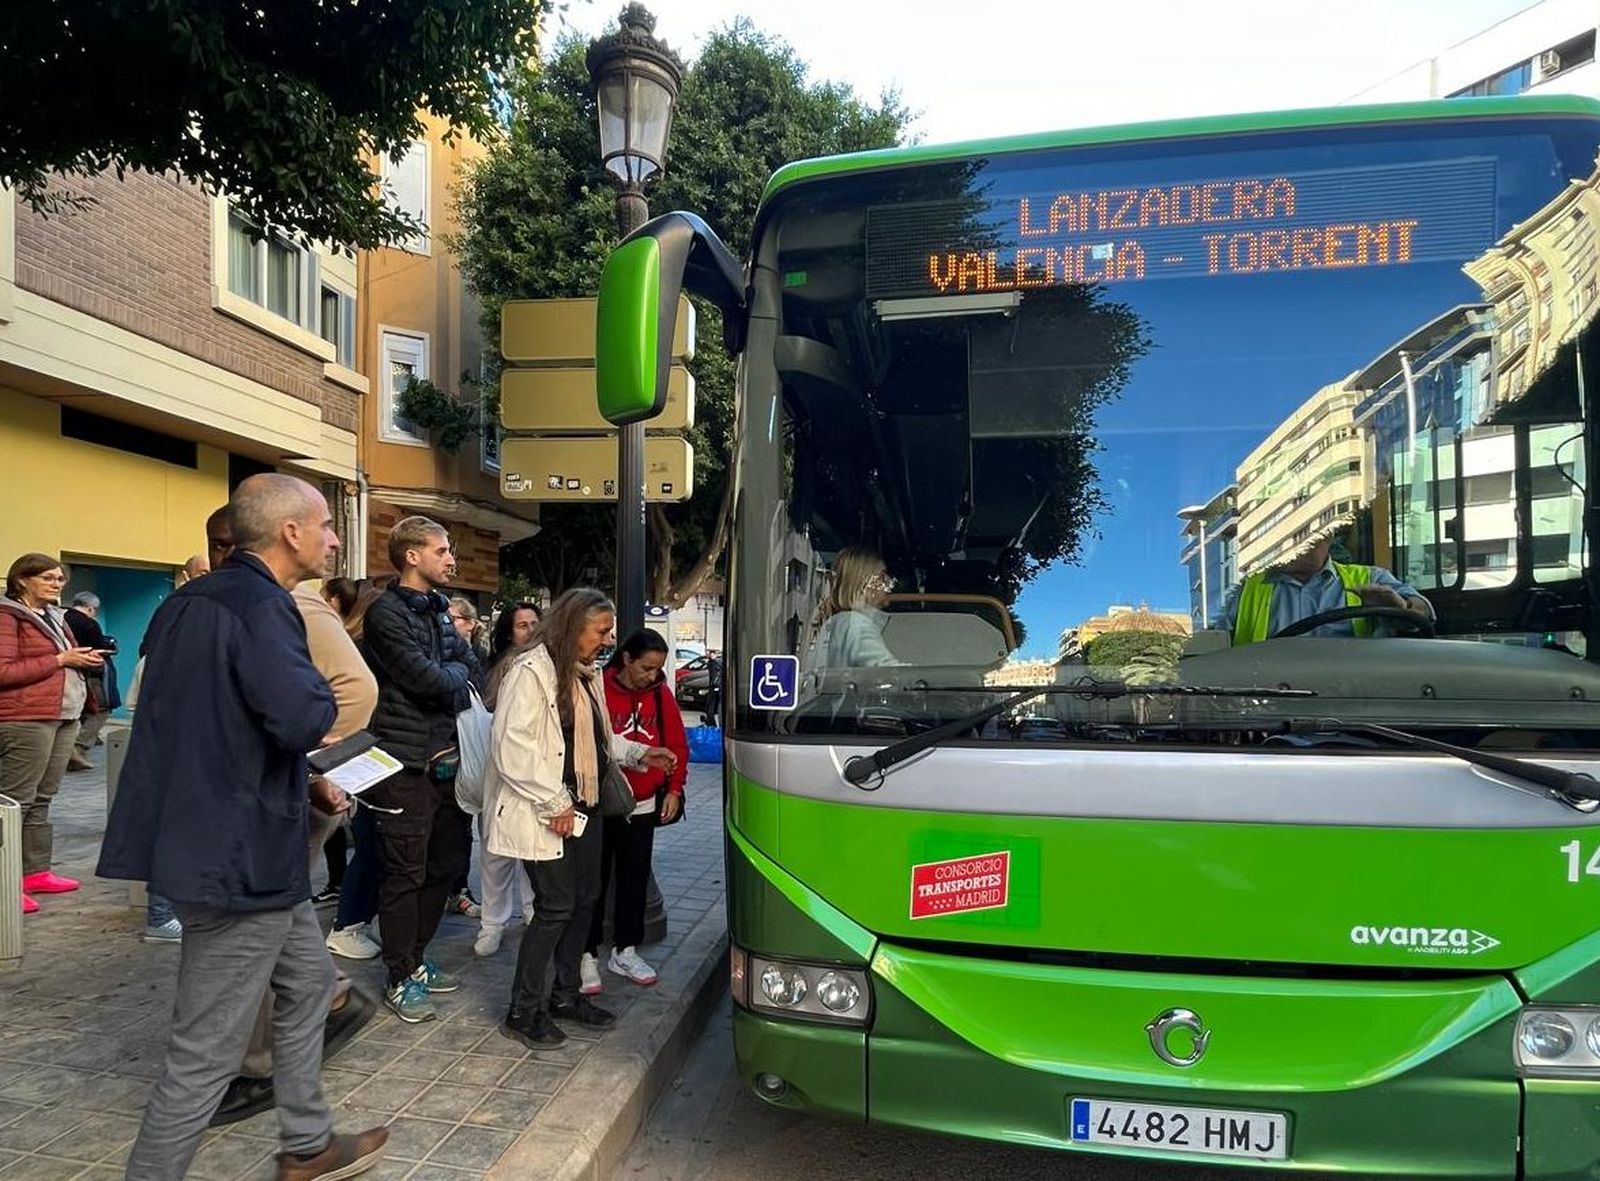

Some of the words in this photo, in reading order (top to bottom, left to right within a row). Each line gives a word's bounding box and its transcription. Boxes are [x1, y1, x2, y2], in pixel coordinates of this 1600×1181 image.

[1019, 178, 1296, 237] LANZADERA
[927, 240, 1146, 293] VALENCIA
[1203, 220, 1418, 273] TORRENT
[935, 857, 1002, 880] CONSORCIO
[918, 873, 1001, 897] TRANSPORTES
[955, 888, 1000, 907] MADRID
[1350, 926, 1469, 946] avanza
[1077, 1124, 1086, 1134] E
[1097, 1107, 1190, 1145] 4482
[1204, 1116, 1276, 1152] HMJ
